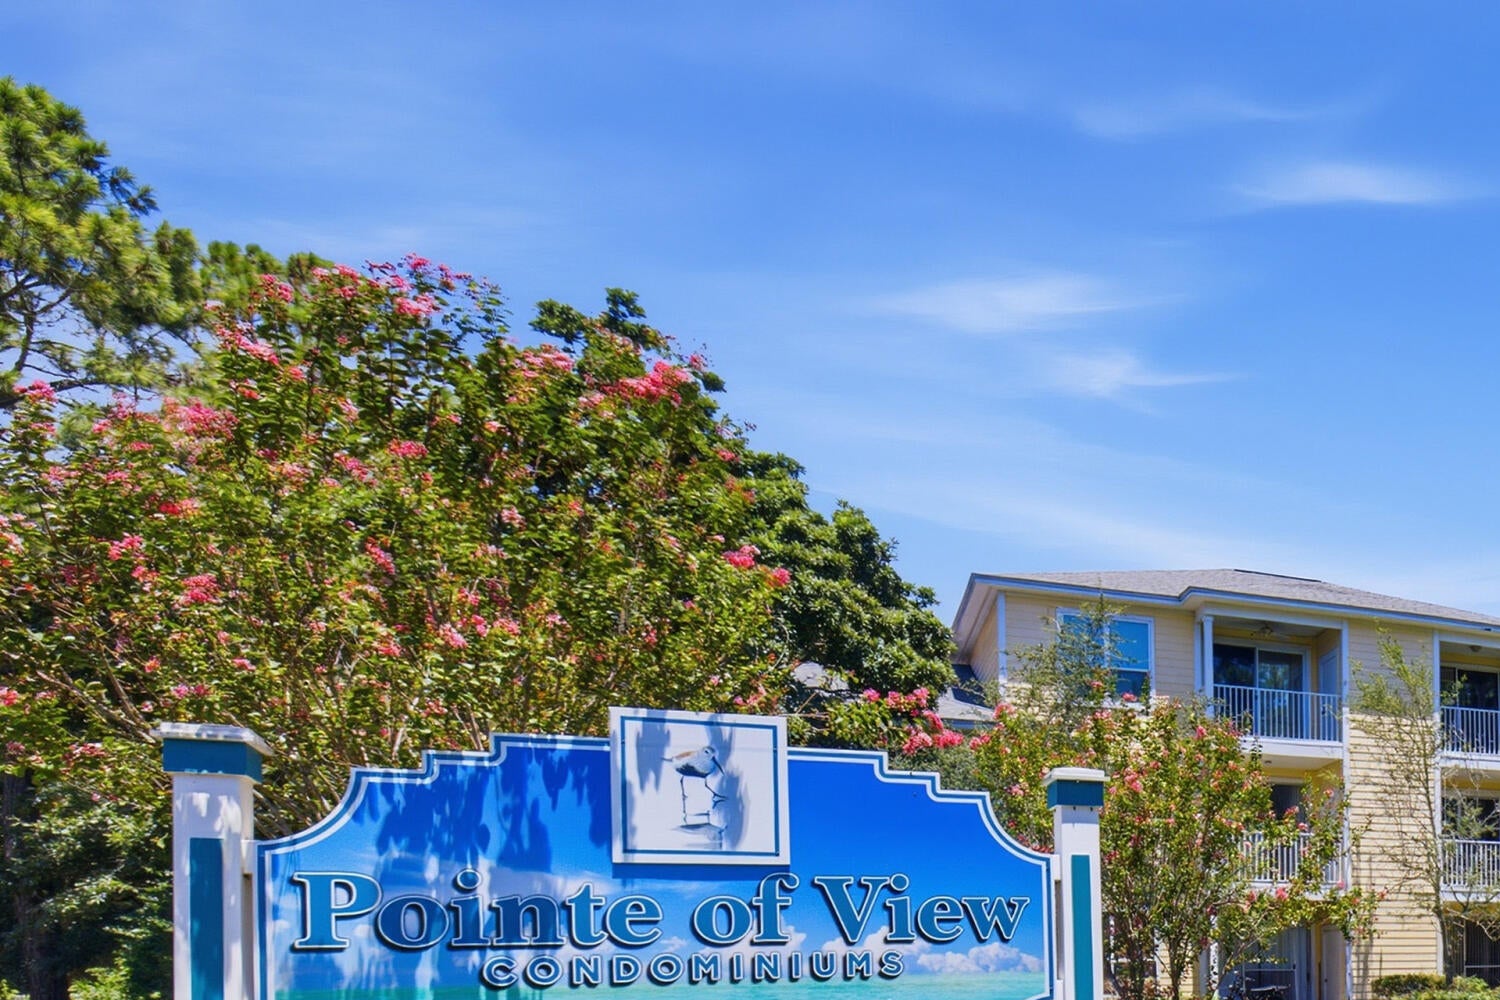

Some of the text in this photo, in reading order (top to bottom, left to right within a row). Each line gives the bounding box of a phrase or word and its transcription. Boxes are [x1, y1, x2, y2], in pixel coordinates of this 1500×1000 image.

[292, 868, 1031, 950] Pointe of View
[481, 950, 905, 987] CONDOMINIUMS
